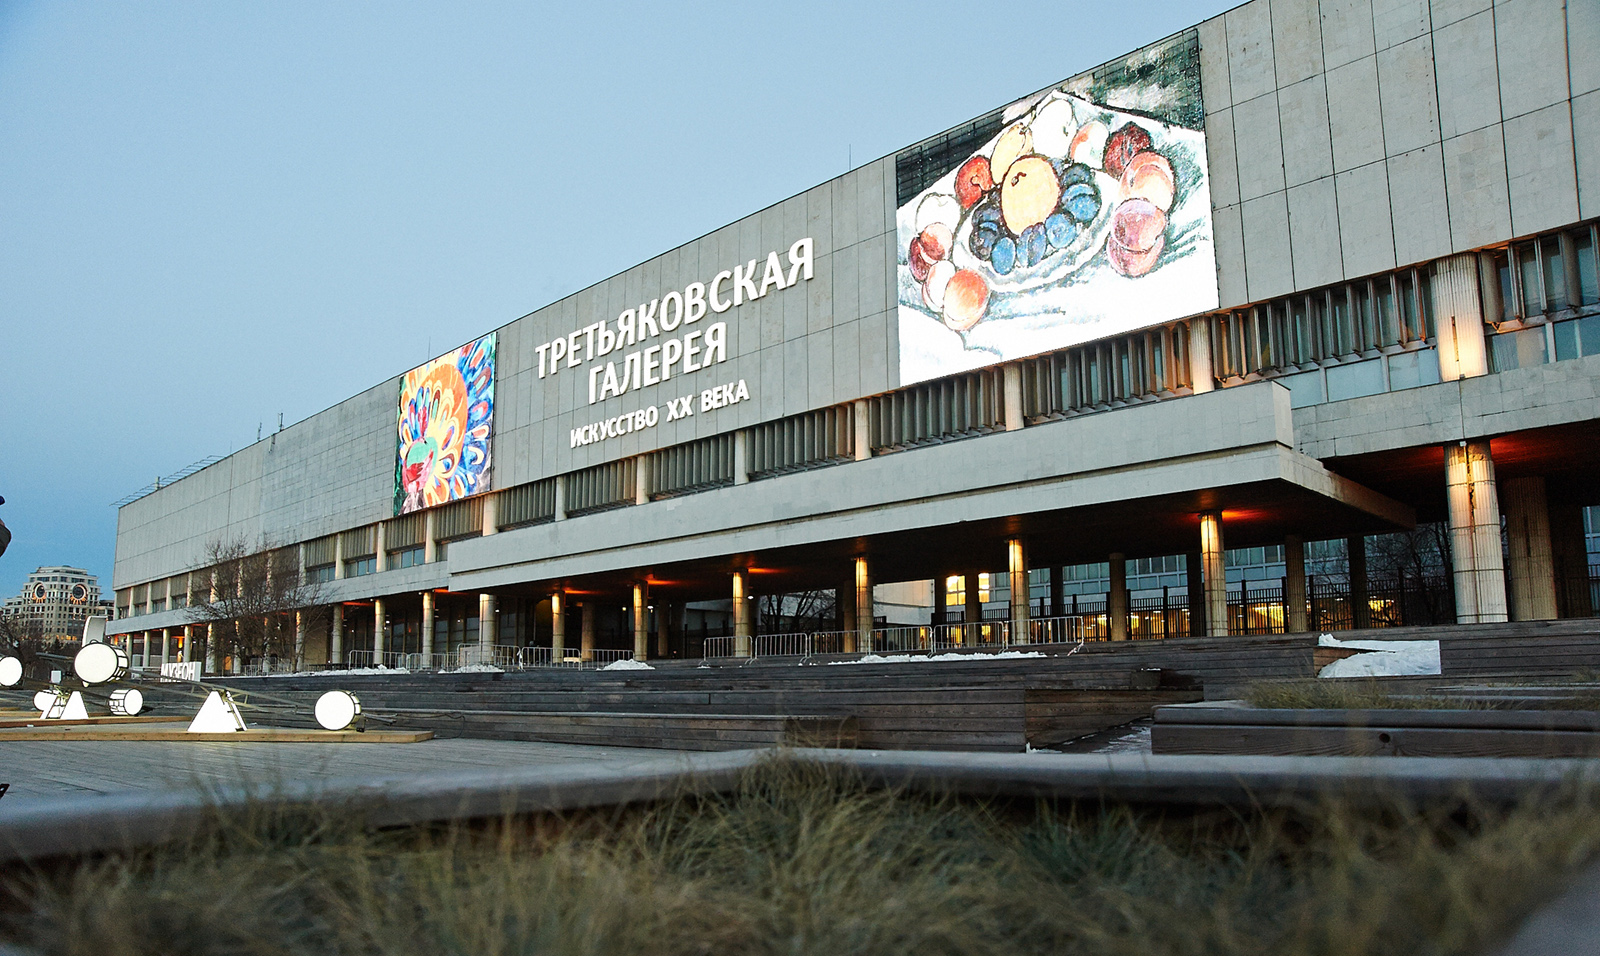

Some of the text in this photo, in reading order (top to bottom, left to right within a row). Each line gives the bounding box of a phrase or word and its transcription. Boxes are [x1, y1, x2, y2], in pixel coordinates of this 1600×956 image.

[535, 237, 814, 379] ТРЕТЬЯКОВСКАЯ
[588, 321, 727, 405] ГАЛЕРЕЯ
[570, 405, 659, 449] ИСКУССТВО
[701, 379, 750, 413] ВЕКА
